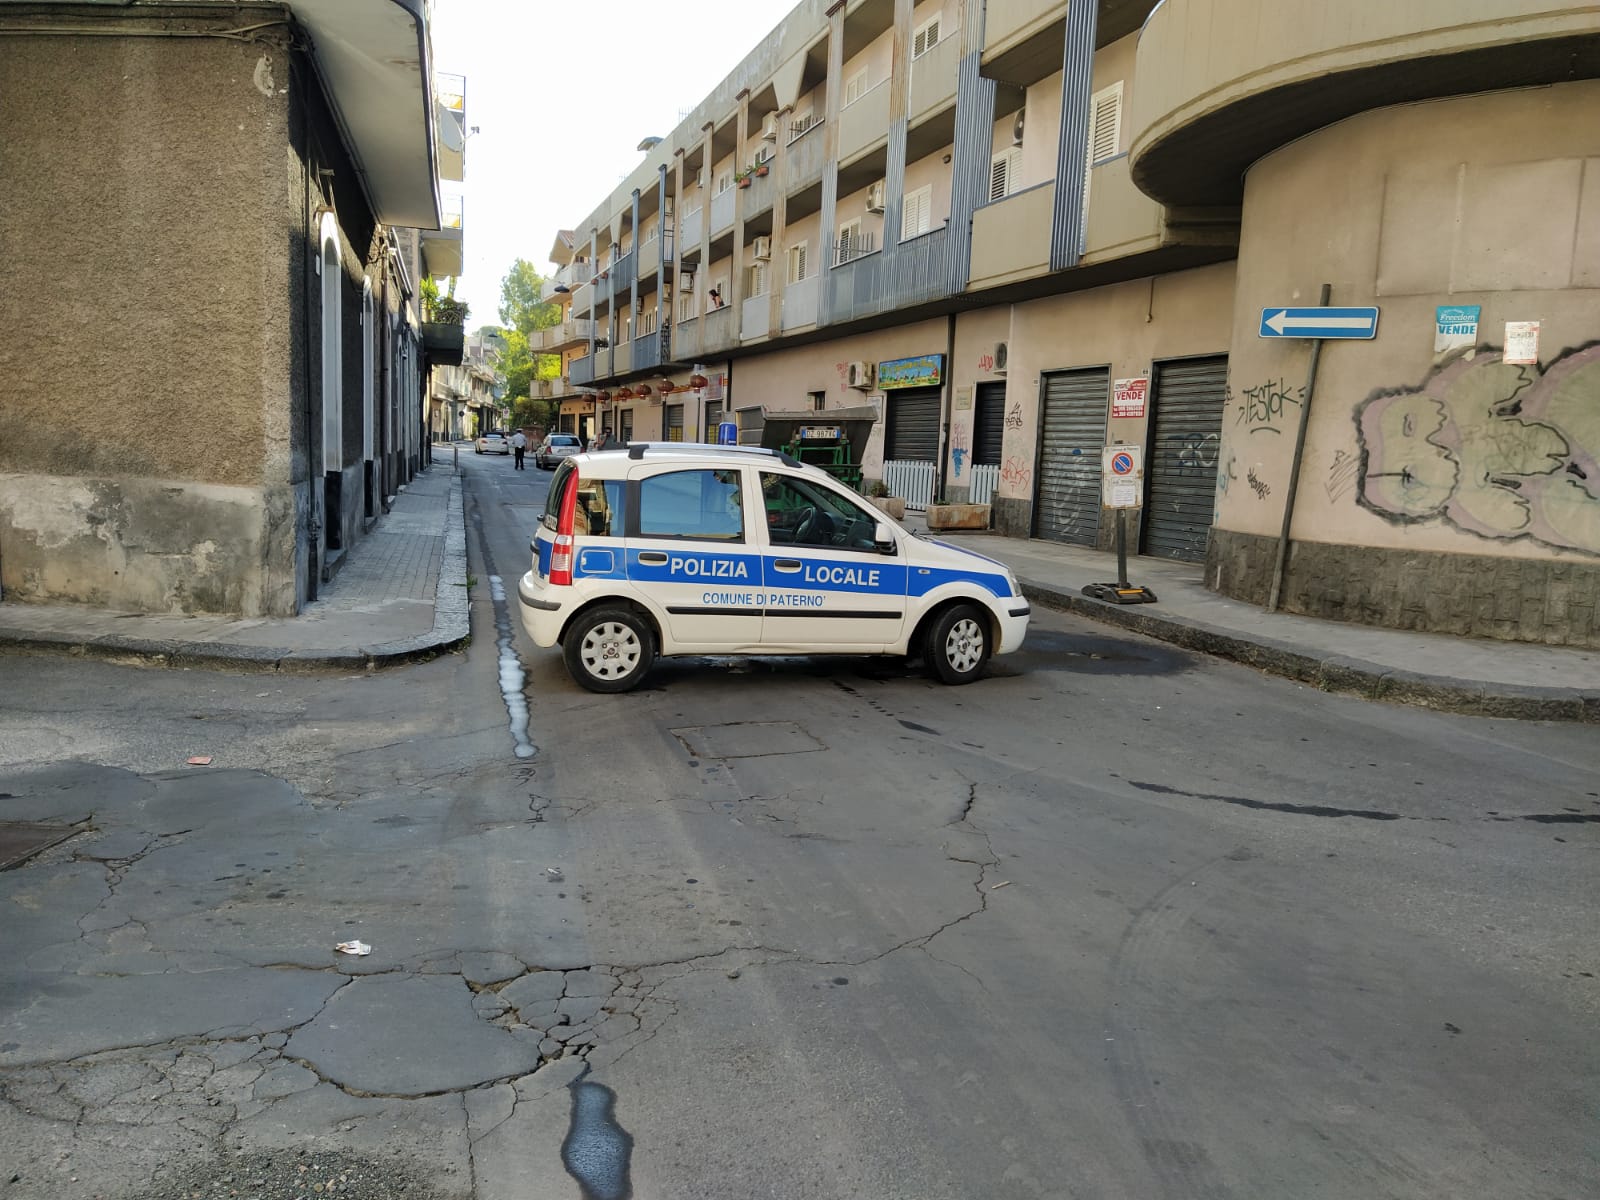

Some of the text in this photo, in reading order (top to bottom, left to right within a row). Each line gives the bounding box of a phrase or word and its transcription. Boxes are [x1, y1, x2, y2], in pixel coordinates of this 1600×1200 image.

[1438, 325, 1475, 335] VENDE
[1116, 390, 1143, 401] VENDE
[670, 557, 881, 587] POLIZIA LOCALE
[702, 592, 753, 606] COMUNE
[755, 593, 767, 605] DI
